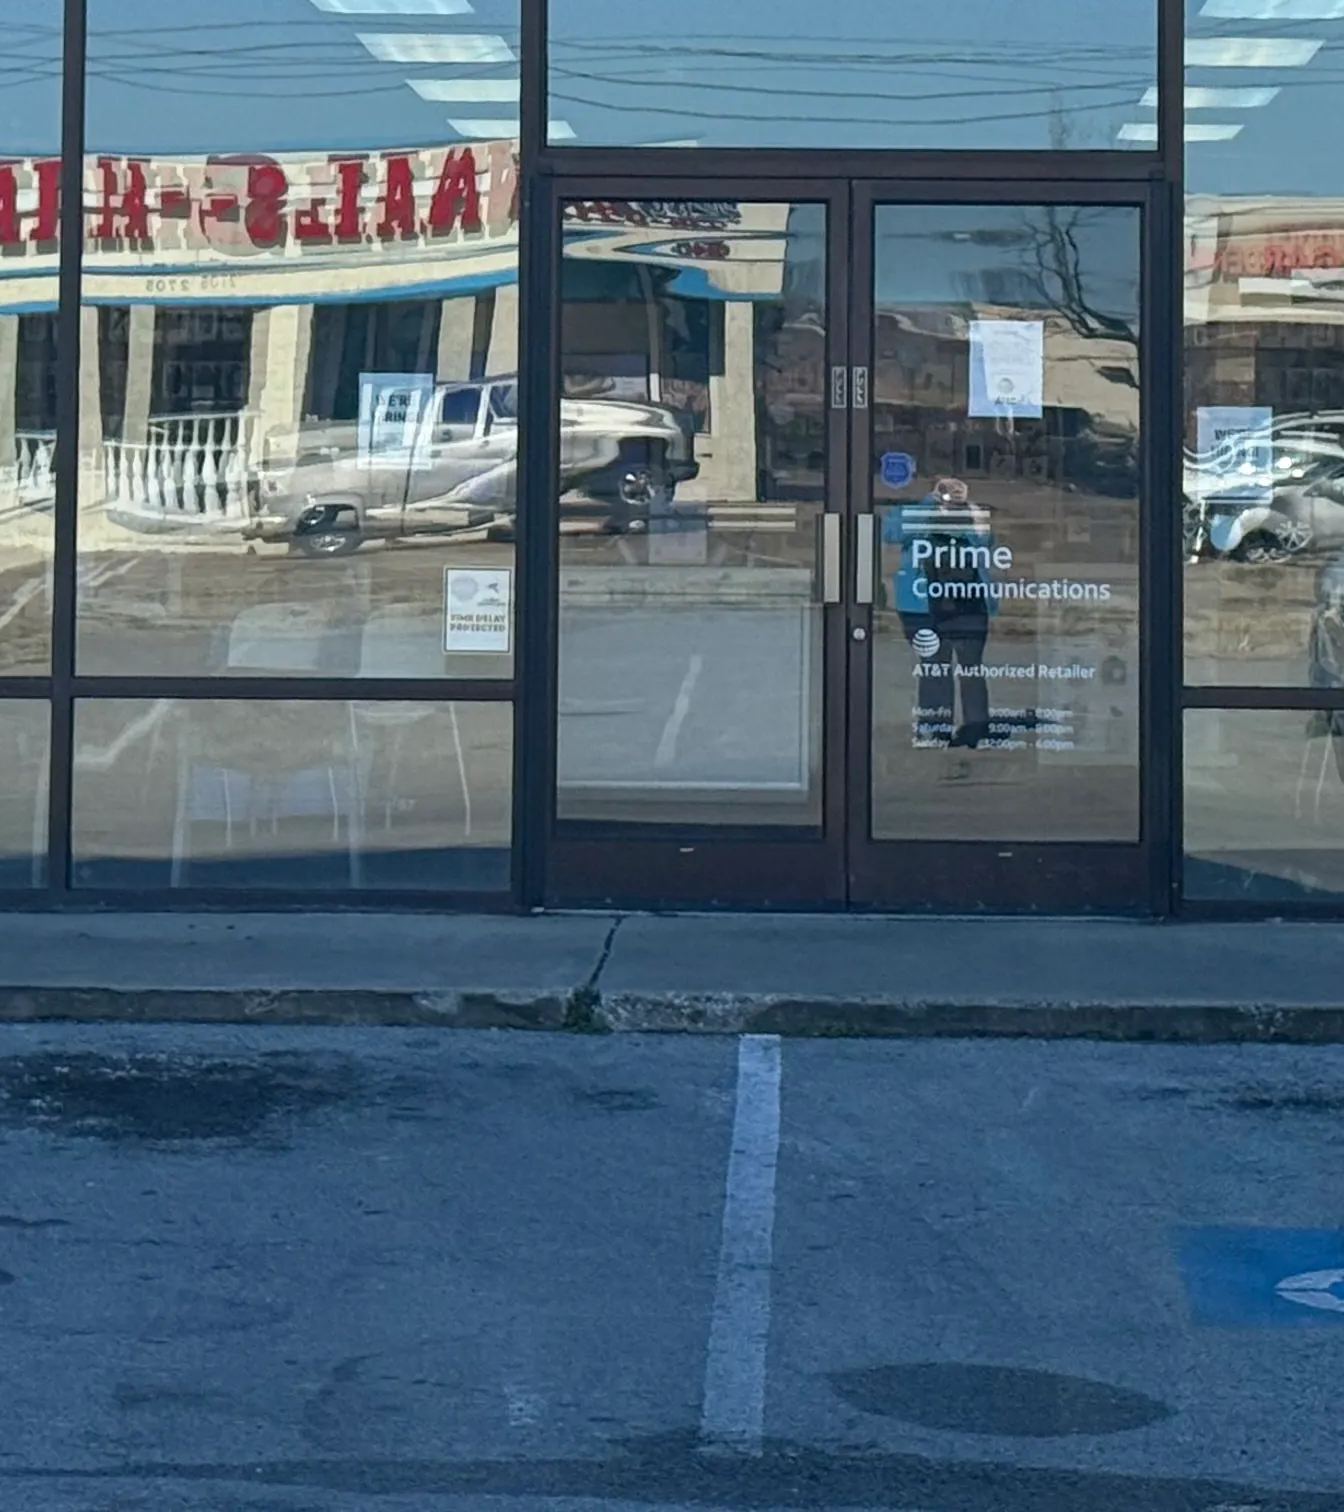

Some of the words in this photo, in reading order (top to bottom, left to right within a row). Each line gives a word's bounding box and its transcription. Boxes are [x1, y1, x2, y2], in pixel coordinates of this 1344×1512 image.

[911, 538, 1013, 570] Prime
[911, 577, 1112, 600] Communications
[911, 663, 951, 678] AT&T
[955, 663, 1036, 679] Authorized
[1037, 663, 1096, 680] Retailer
